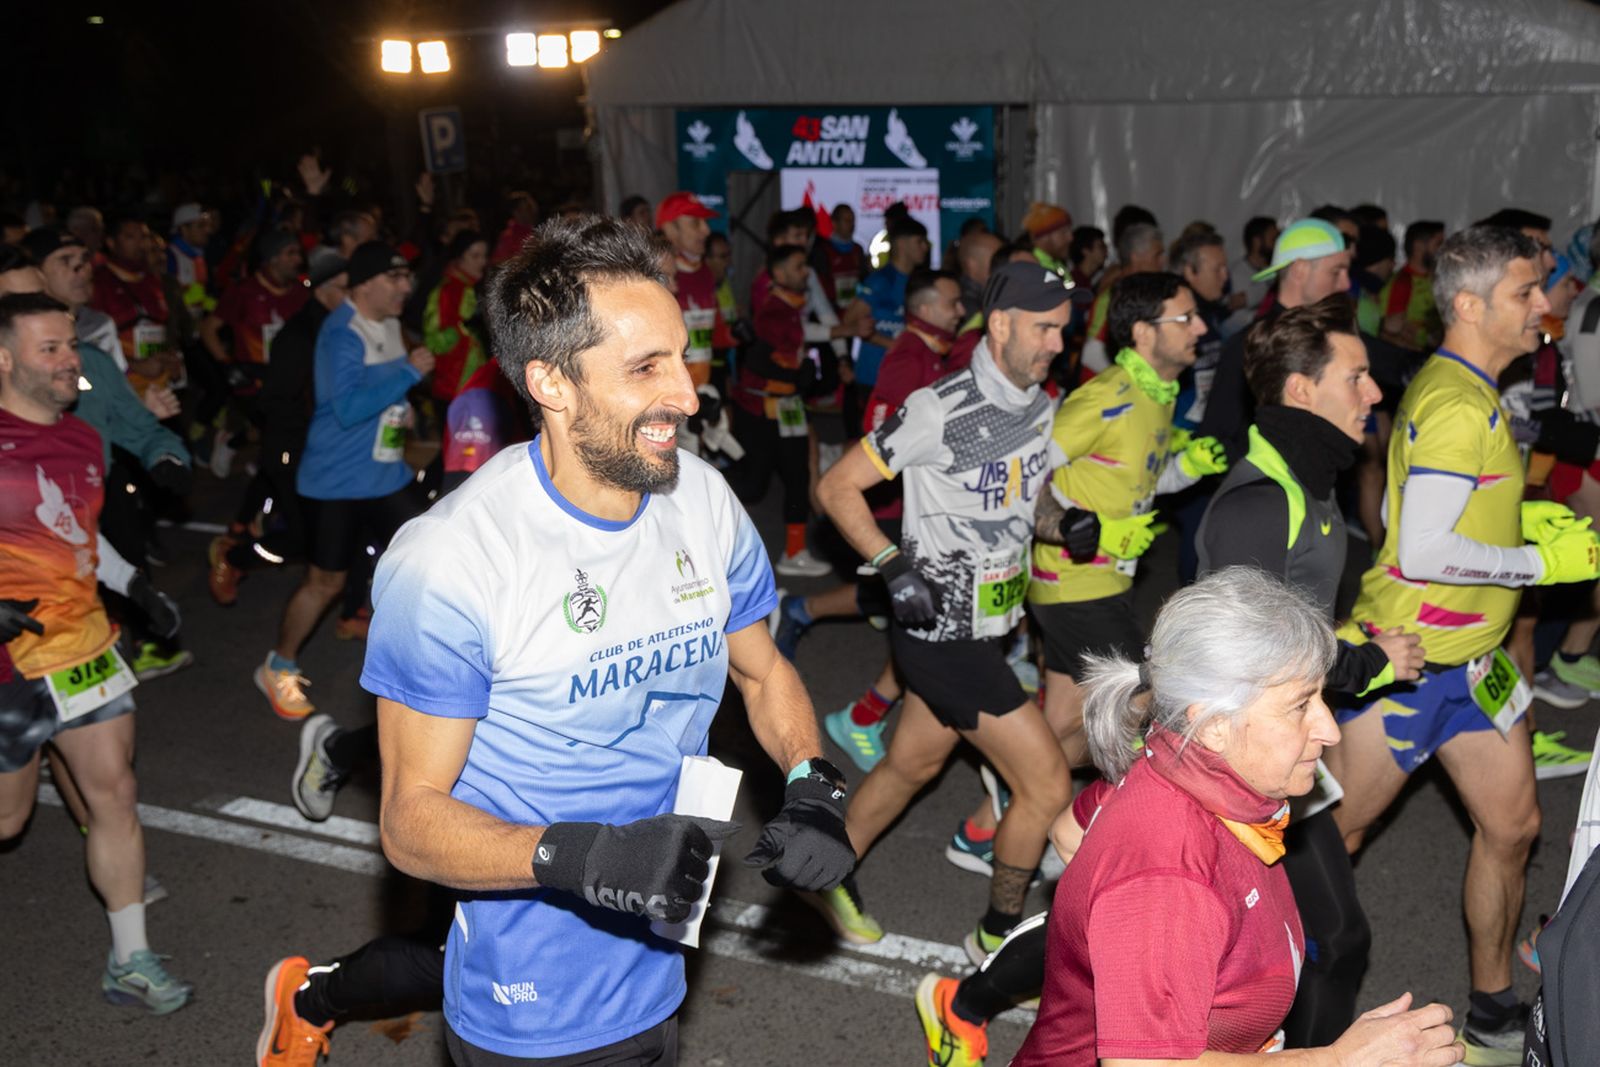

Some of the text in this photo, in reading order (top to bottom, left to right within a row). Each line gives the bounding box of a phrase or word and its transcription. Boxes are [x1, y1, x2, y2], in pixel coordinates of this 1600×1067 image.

[431, 115, 456, 151] P
[590, 617, 714, 663] CLUB DE ATLETISMO
[510, 982, 534, 997] RUN
[514, 991, 538, 1004] PRO
